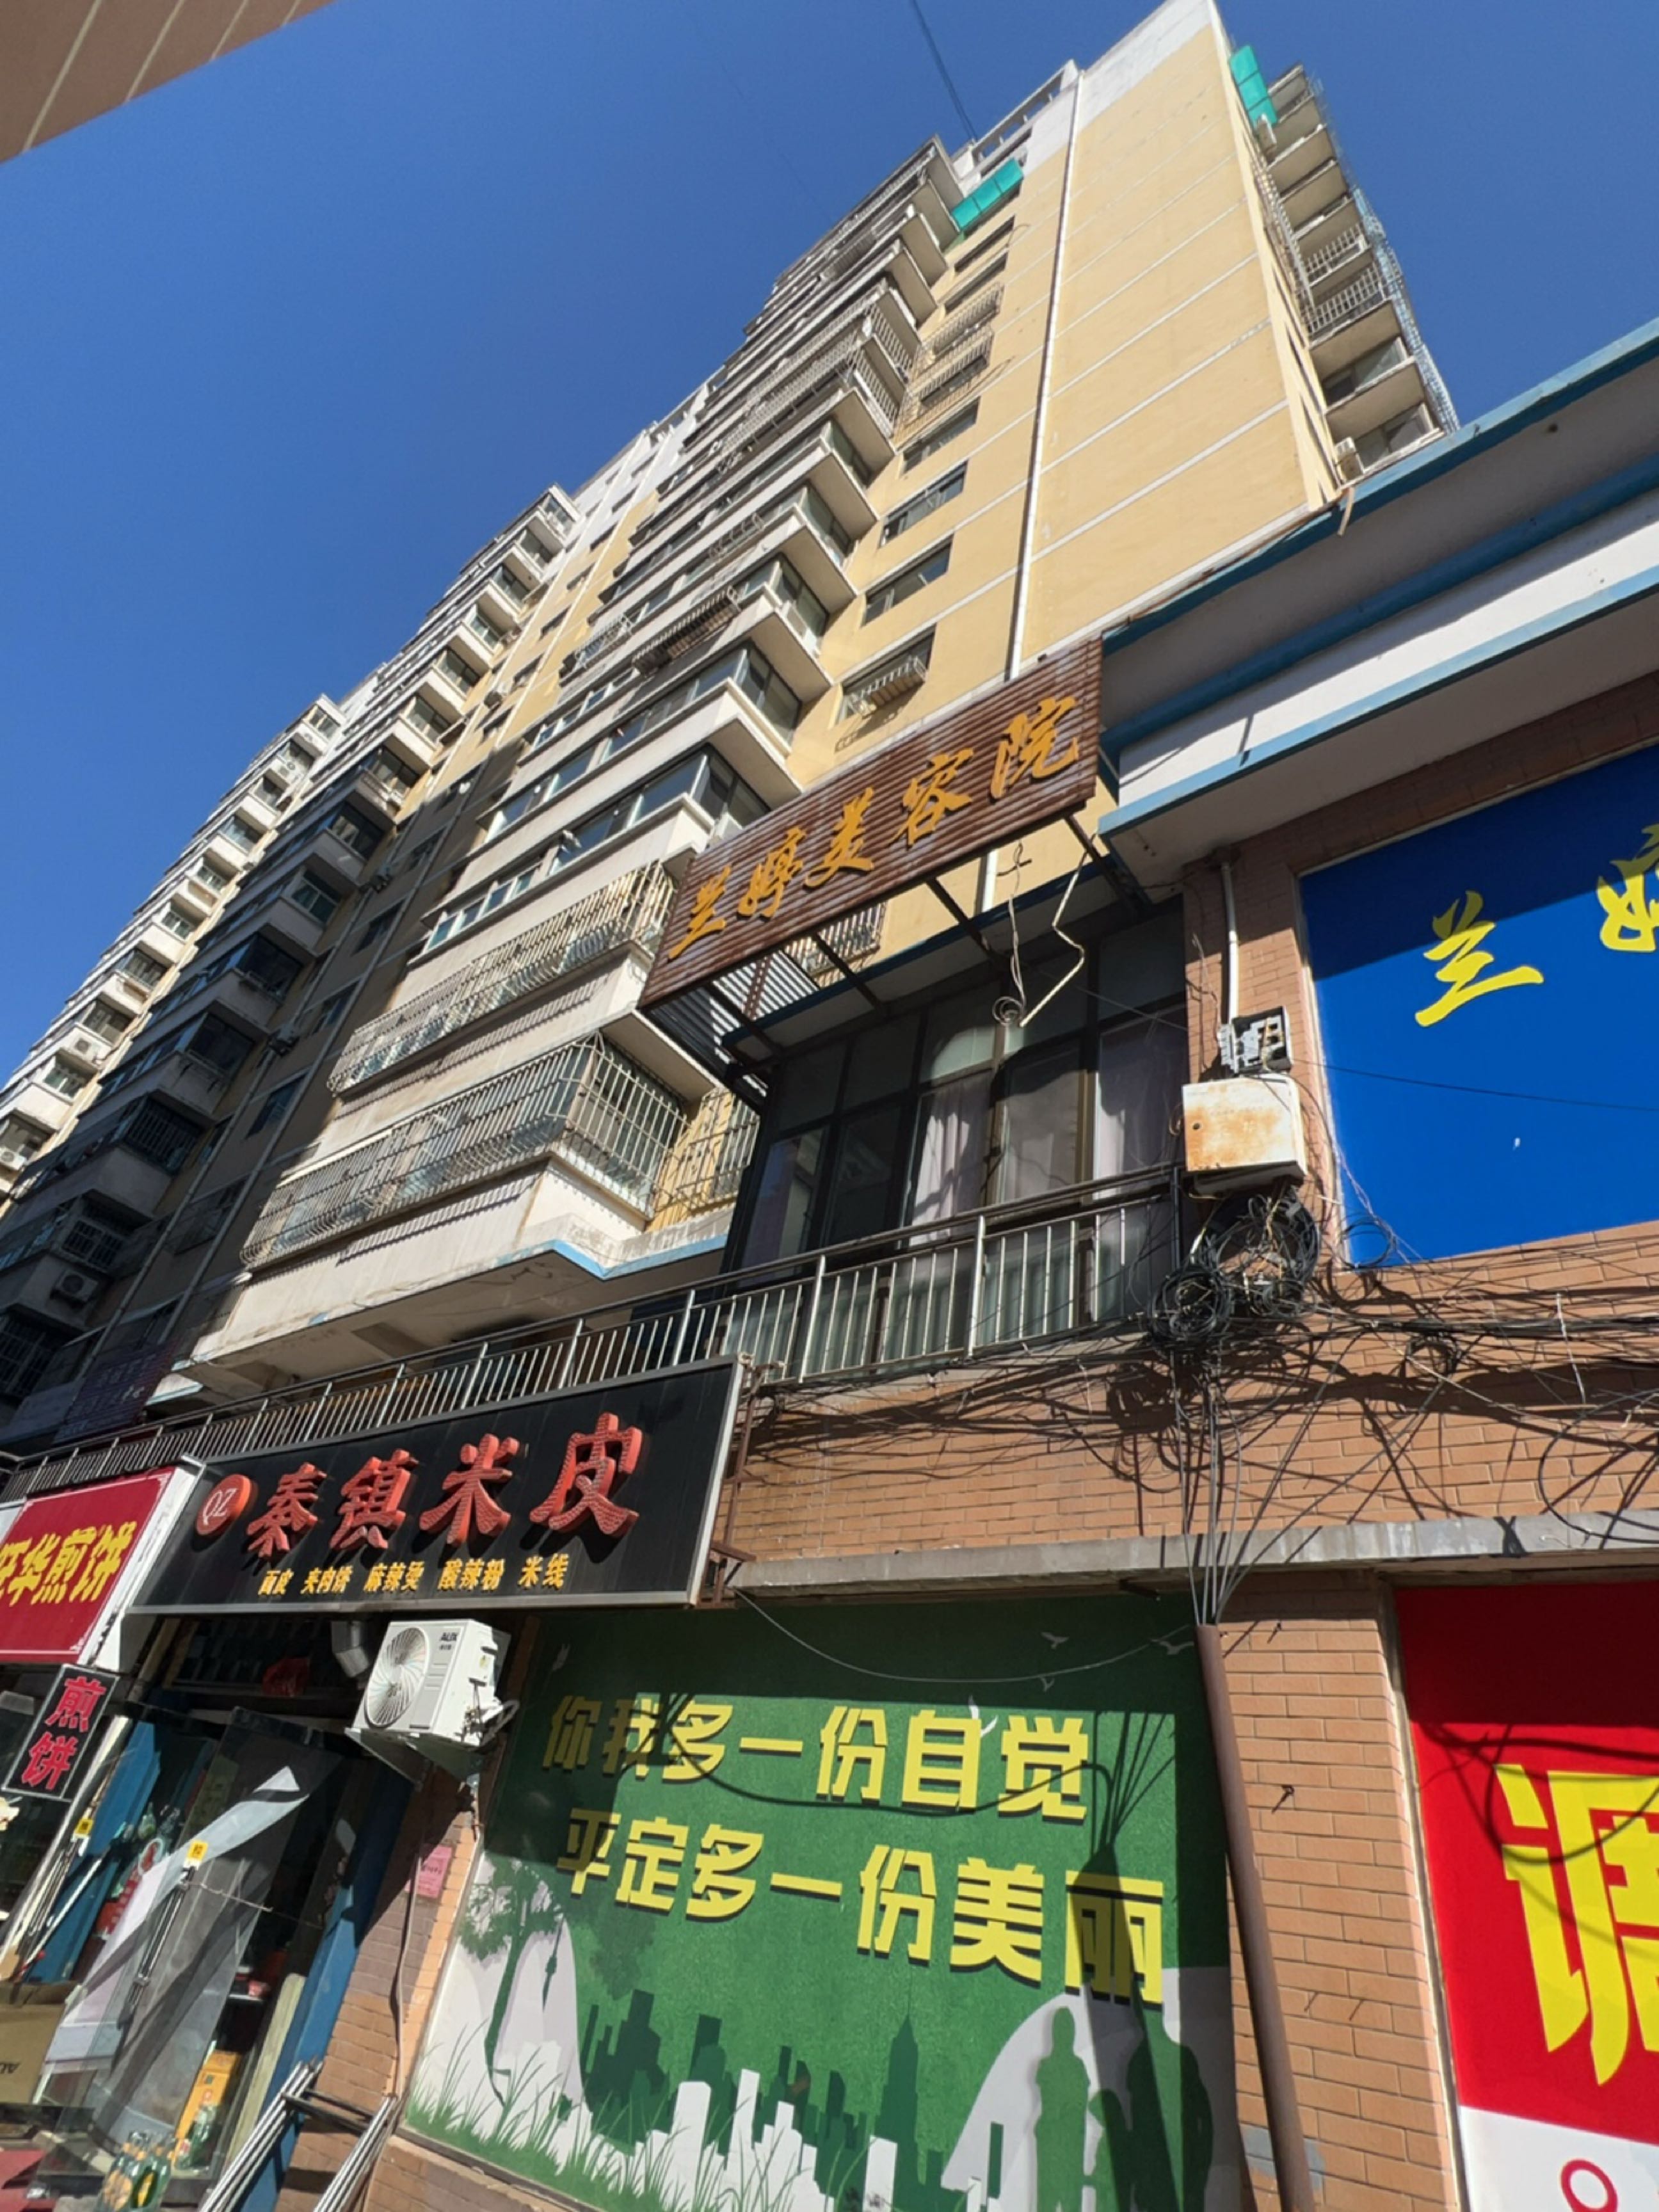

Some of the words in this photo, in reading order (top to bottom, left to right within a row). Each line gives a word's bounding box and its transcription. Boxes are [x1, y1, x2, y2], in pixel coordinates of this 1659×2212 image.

[668, 696, 1079, 959] 兰婷美容院
[363, 1560, 424, 1592] 麻辣烫
[438, 1558, 506, 1592] 酸辣粉
[518, 1553, 569, 1590] 米线
[22, 1676, 108, 1790] 煎饼
[541, 1694, 1089, 1821] 你我多一份自觉
[556, 1807, 1164, 2008] 平定多一份美丽
